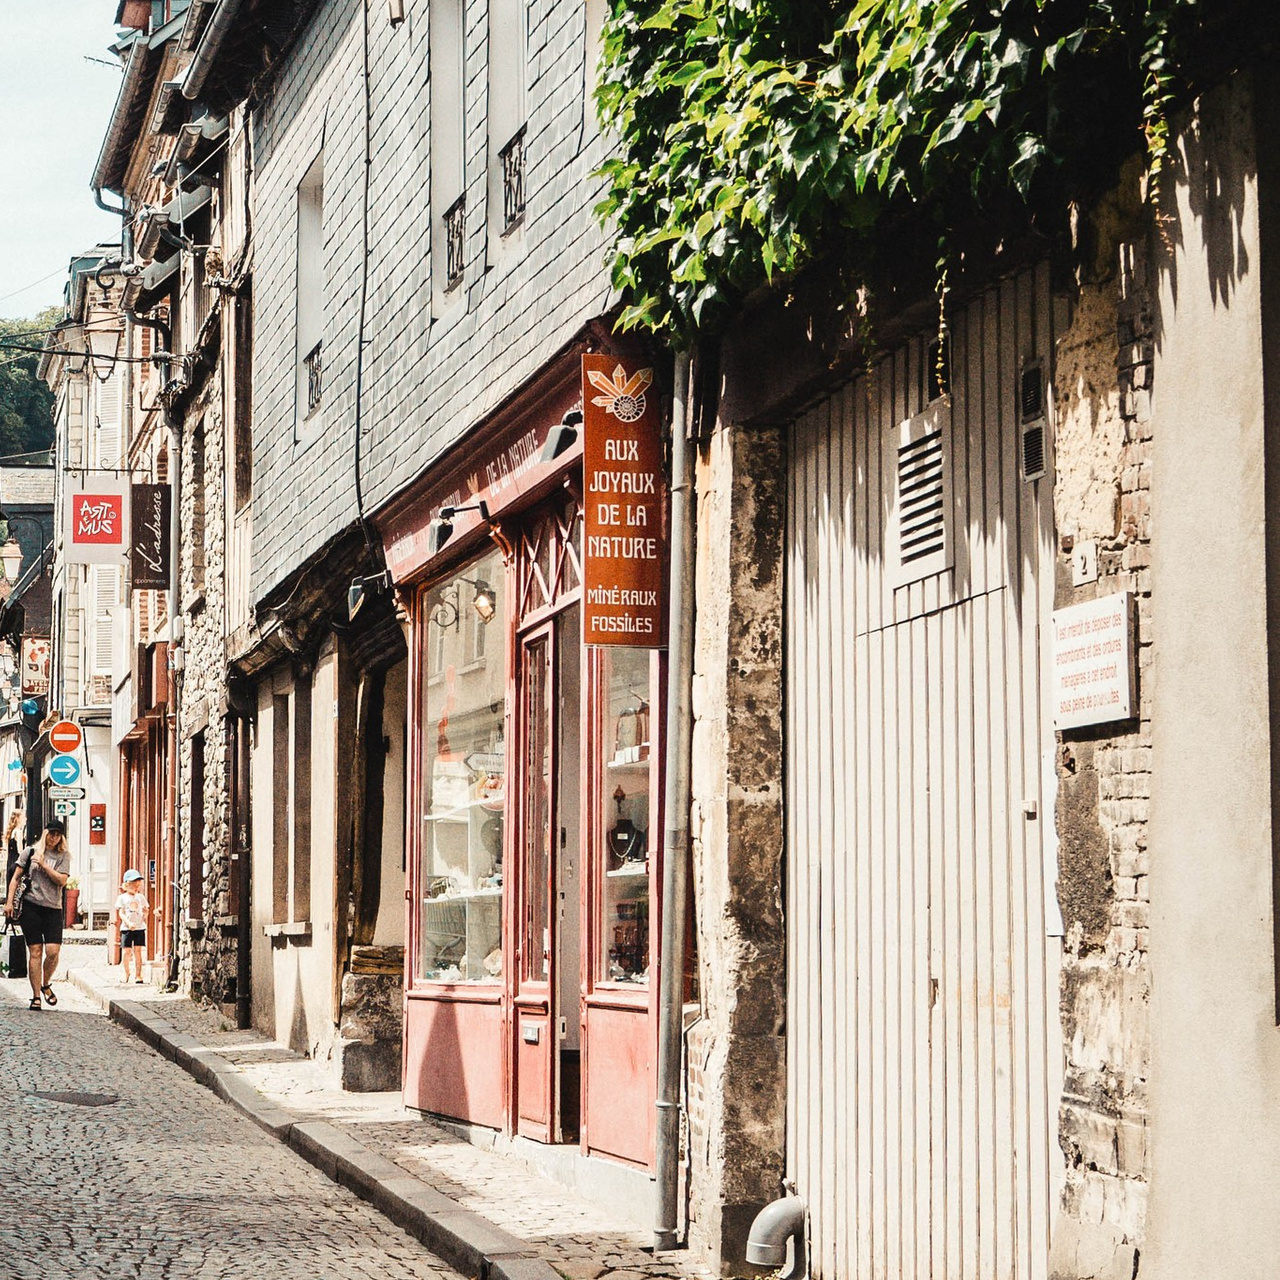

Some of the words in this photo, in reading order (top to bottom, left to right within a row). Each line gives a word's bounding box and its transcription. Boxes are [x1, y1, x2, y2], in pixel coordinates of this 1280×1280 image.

[605, 439, 639, 461] AUX
[486, 461, 500, 498] DE
[497, 453, 512, 488] LA
[589, 471, 655, 494] JOYAUX
[597, 504, 620, 526] DE
[626, 504, 647, 526] LA
[78, 519, 113, 536] MUS
[588, 536, 657, 559] NATURE
